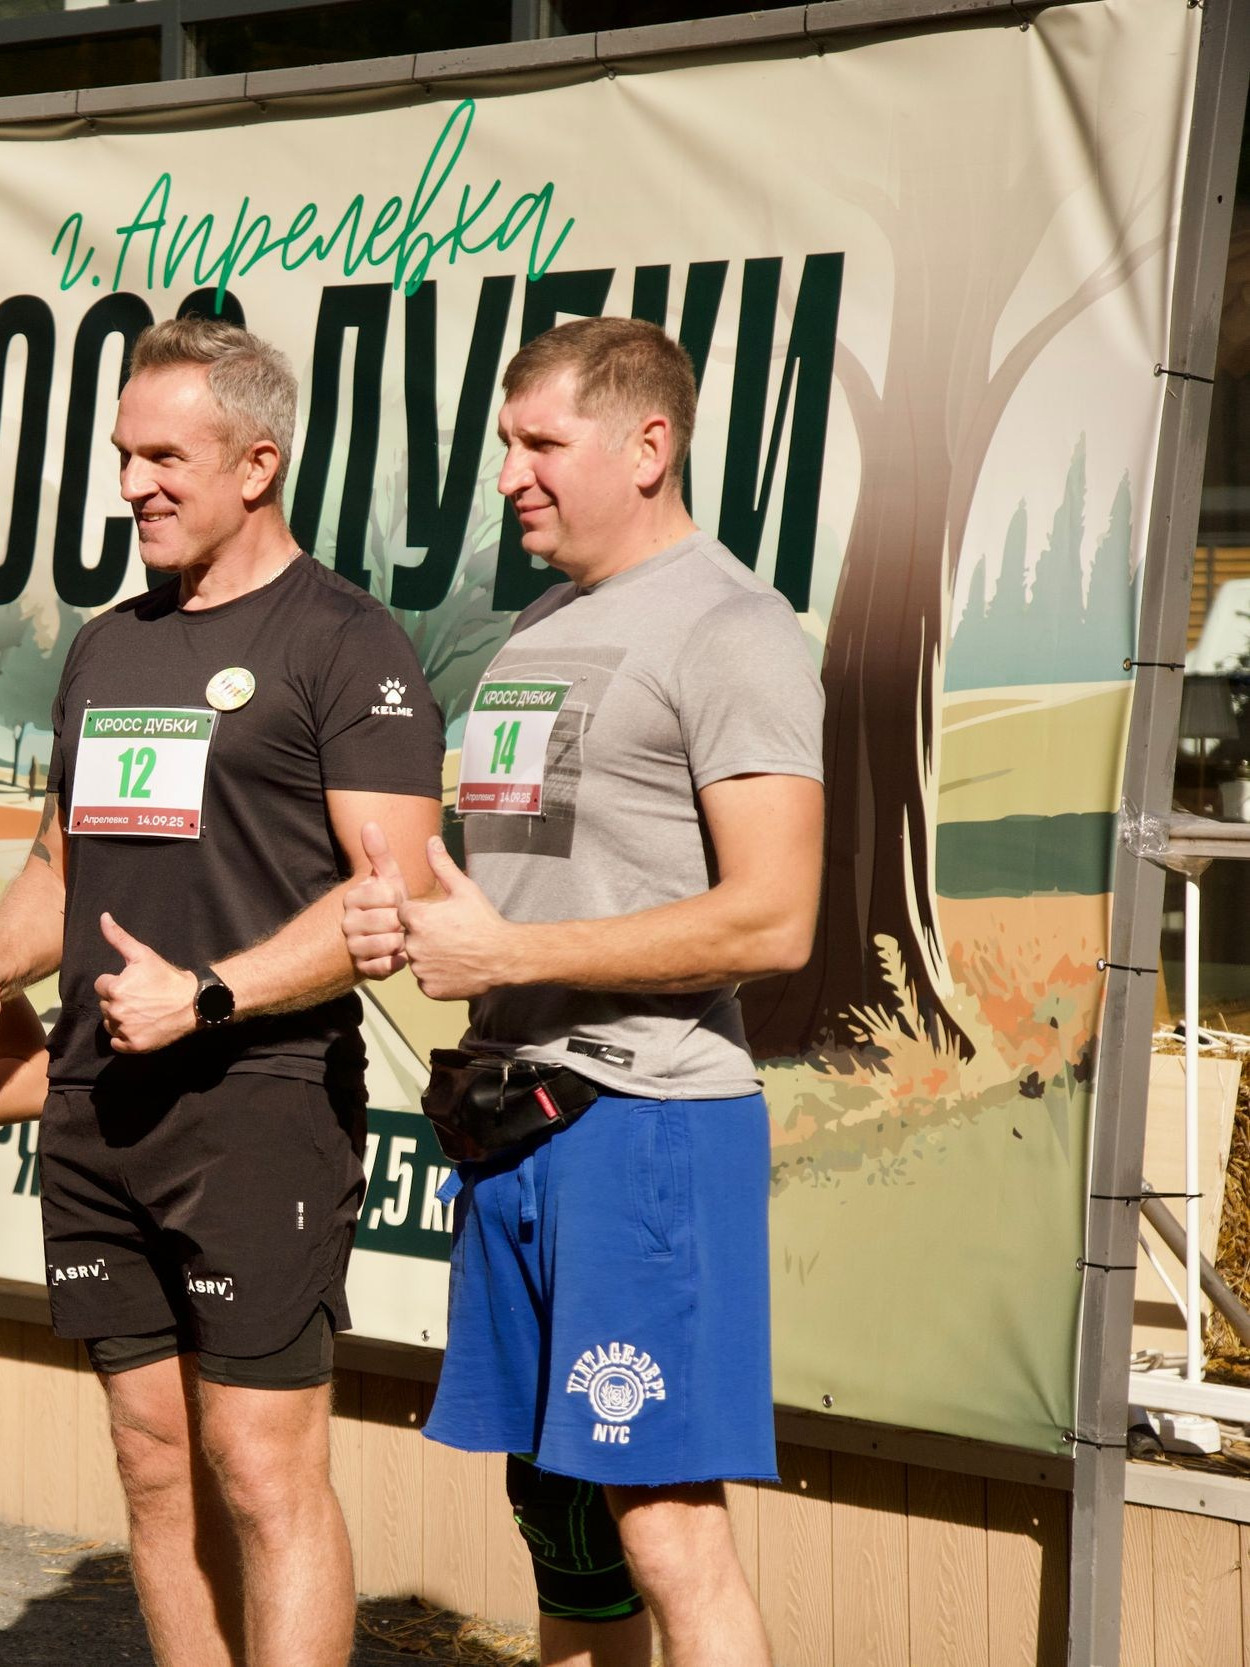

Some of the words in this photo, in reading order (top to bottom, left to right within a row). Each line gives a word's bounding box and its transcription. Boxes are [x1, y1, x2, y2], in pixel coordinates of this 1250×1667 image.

[482, 690, 519, 705] КРОСС
[515, 690, 557, 707] ДУБКИ
[371, 705, 414, 718] KELME
[94, 717, 142, 732] КРОСС
[143, 718, 198, 735] ДУБКИ
[490, 720, 521, 775] 14
[118, 746, 157, 799] 12
[500, 792, 531, 804] 14.09.25
[83, 814, 129, 826] Апрелевка
[137, 814, 184, 828] 14.09.25
[420, 1165, 455, 1233] К
[55, 1264, 100, 1282] ASRV
[188, 1279, 228, 1296] ASRV
[592, 1422, 630, 1444] NYC
